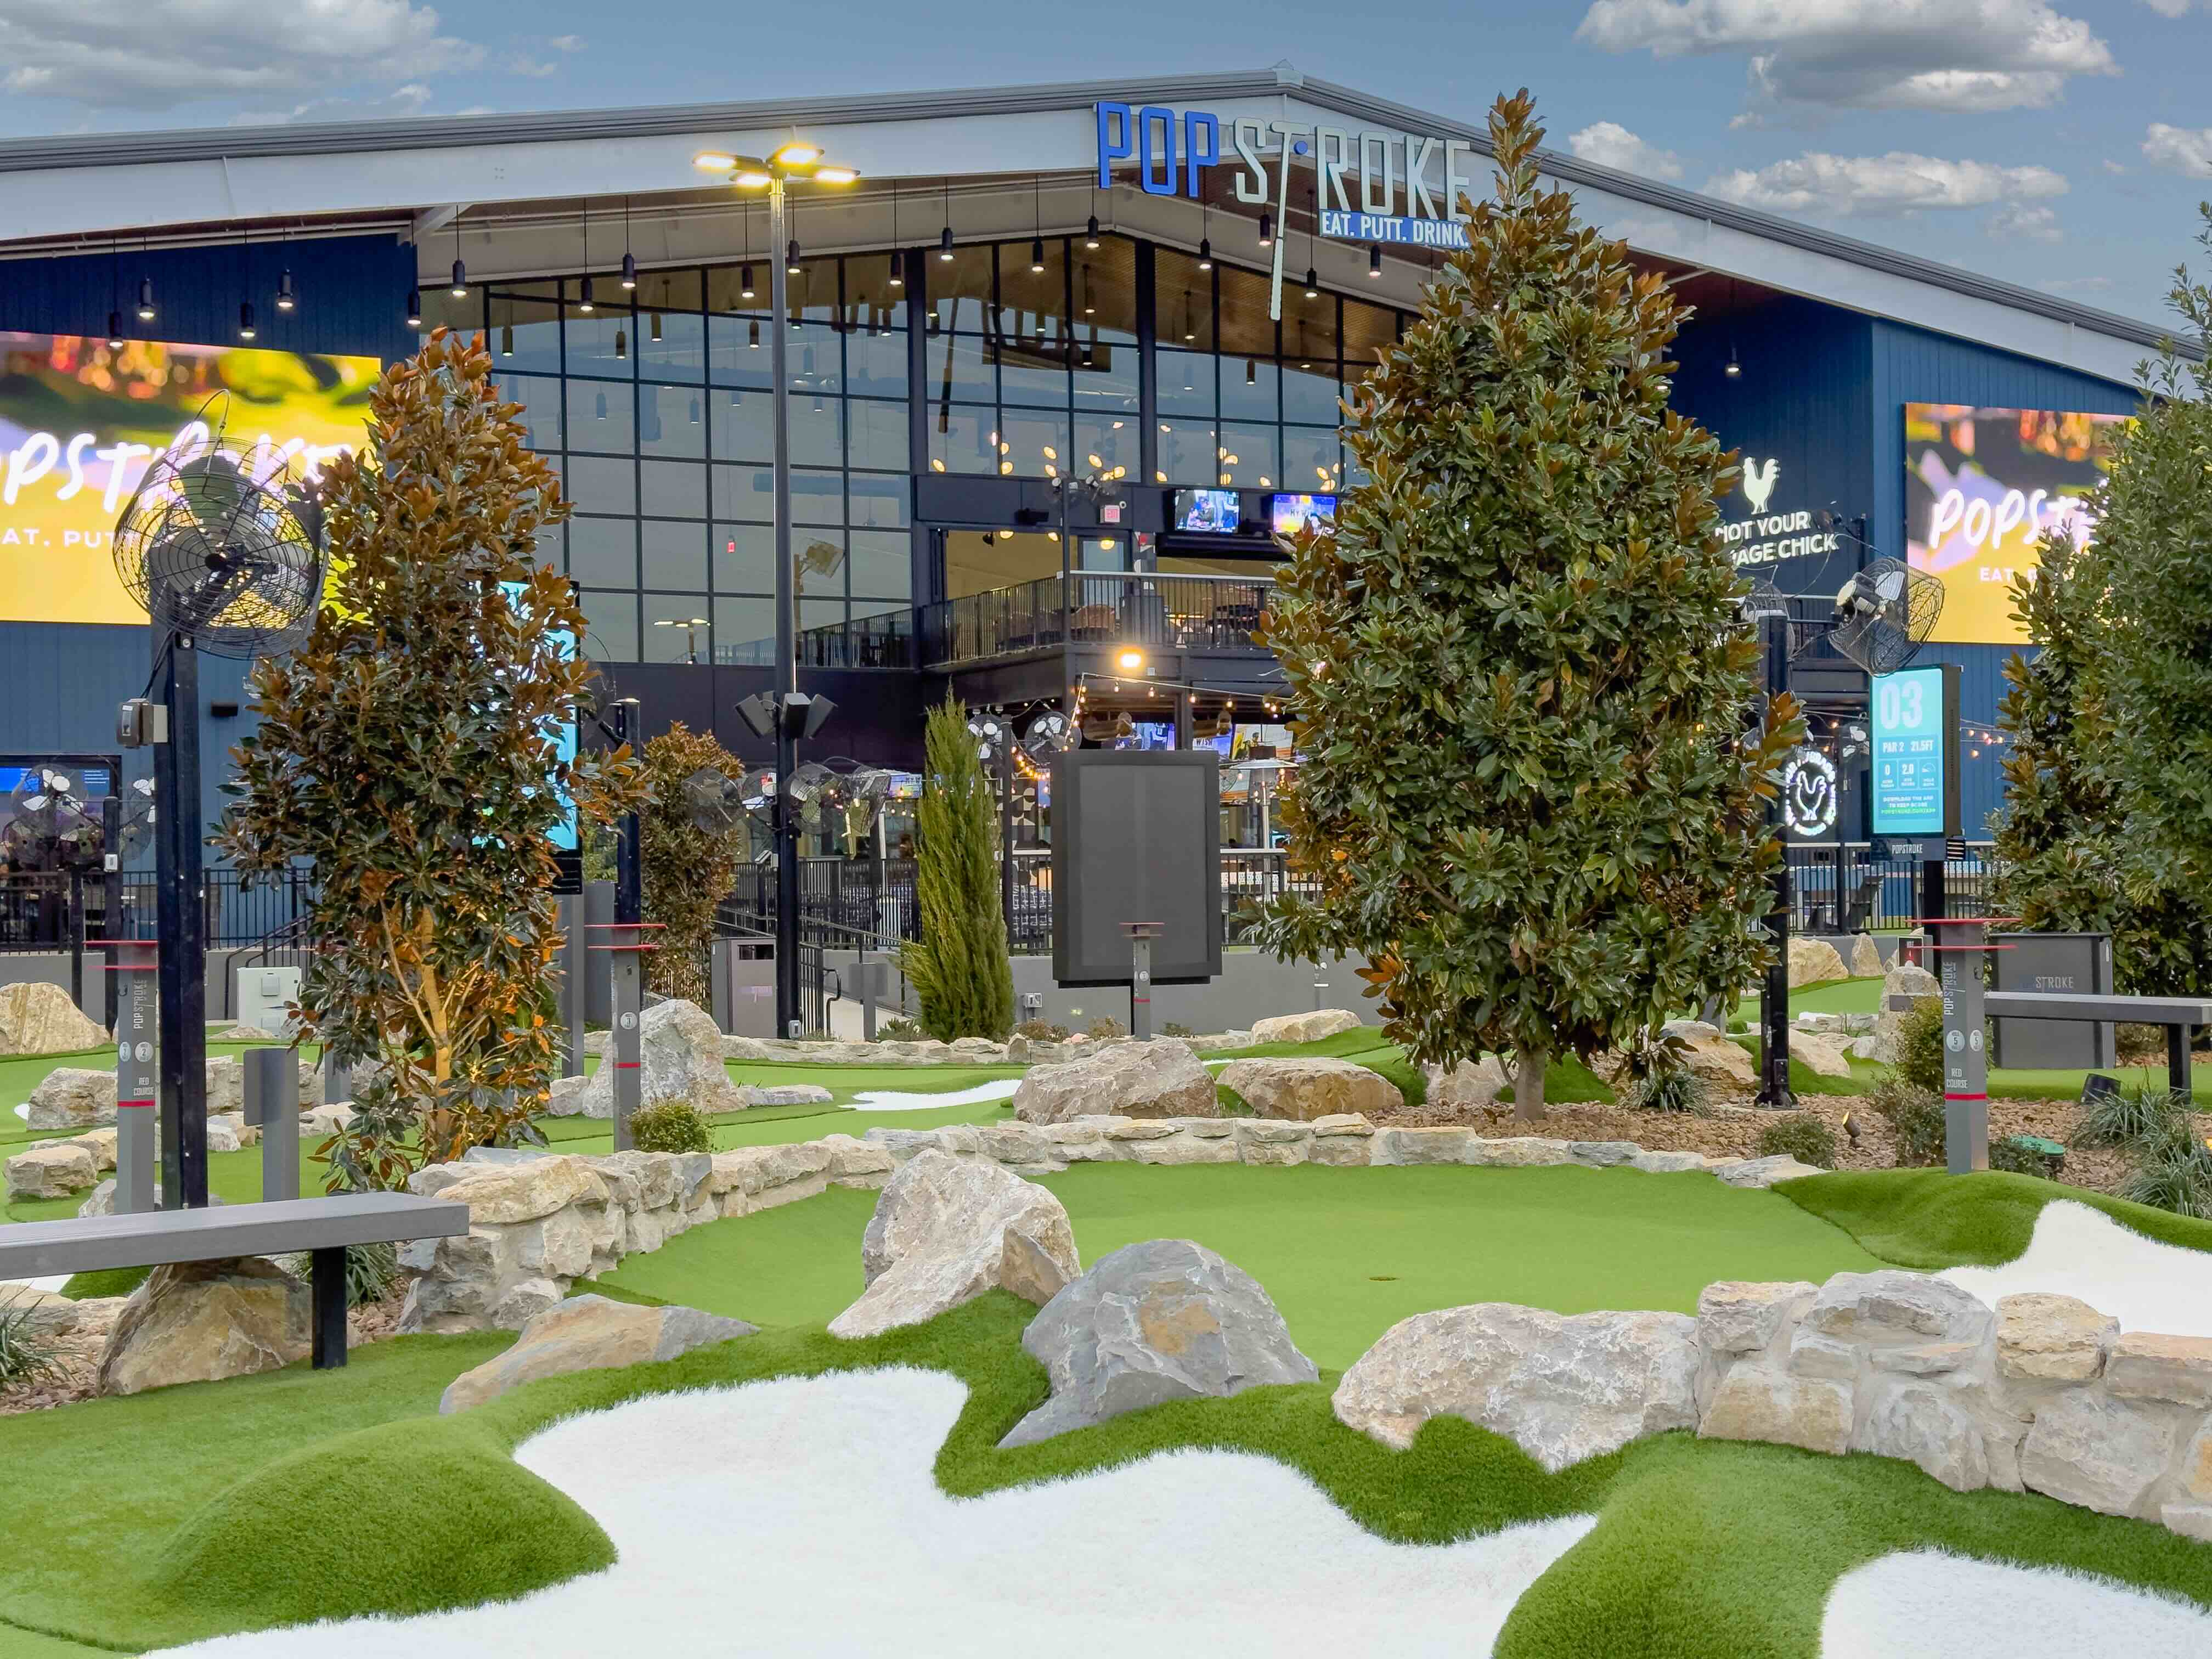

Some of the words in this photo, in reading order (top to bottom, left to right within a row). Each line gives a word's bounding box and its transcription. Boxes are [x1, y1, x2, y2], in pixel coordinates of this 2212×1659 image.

[1322, 212, 1355, 236] EAT.
[1361, 216, 1407, 241] PUTT.
[1413, 221, 1469, 246] DRINK.
[1757, 511, 1811, 537] YOUR
[1778, 533, 1838, 558] CHICK
[1880, 680, 1923, 729] 03
[1882, 742, 1897, 753] PAR
[1899, 741, 1905, 752] 2
[1892, 843, 1923, 854] POPSTROKE
[1954, 1037, 1958, 1045] 5
[1951, 1068, 1962, 1077] RED
[1946, 1079, 1968, 1088] COURSE
